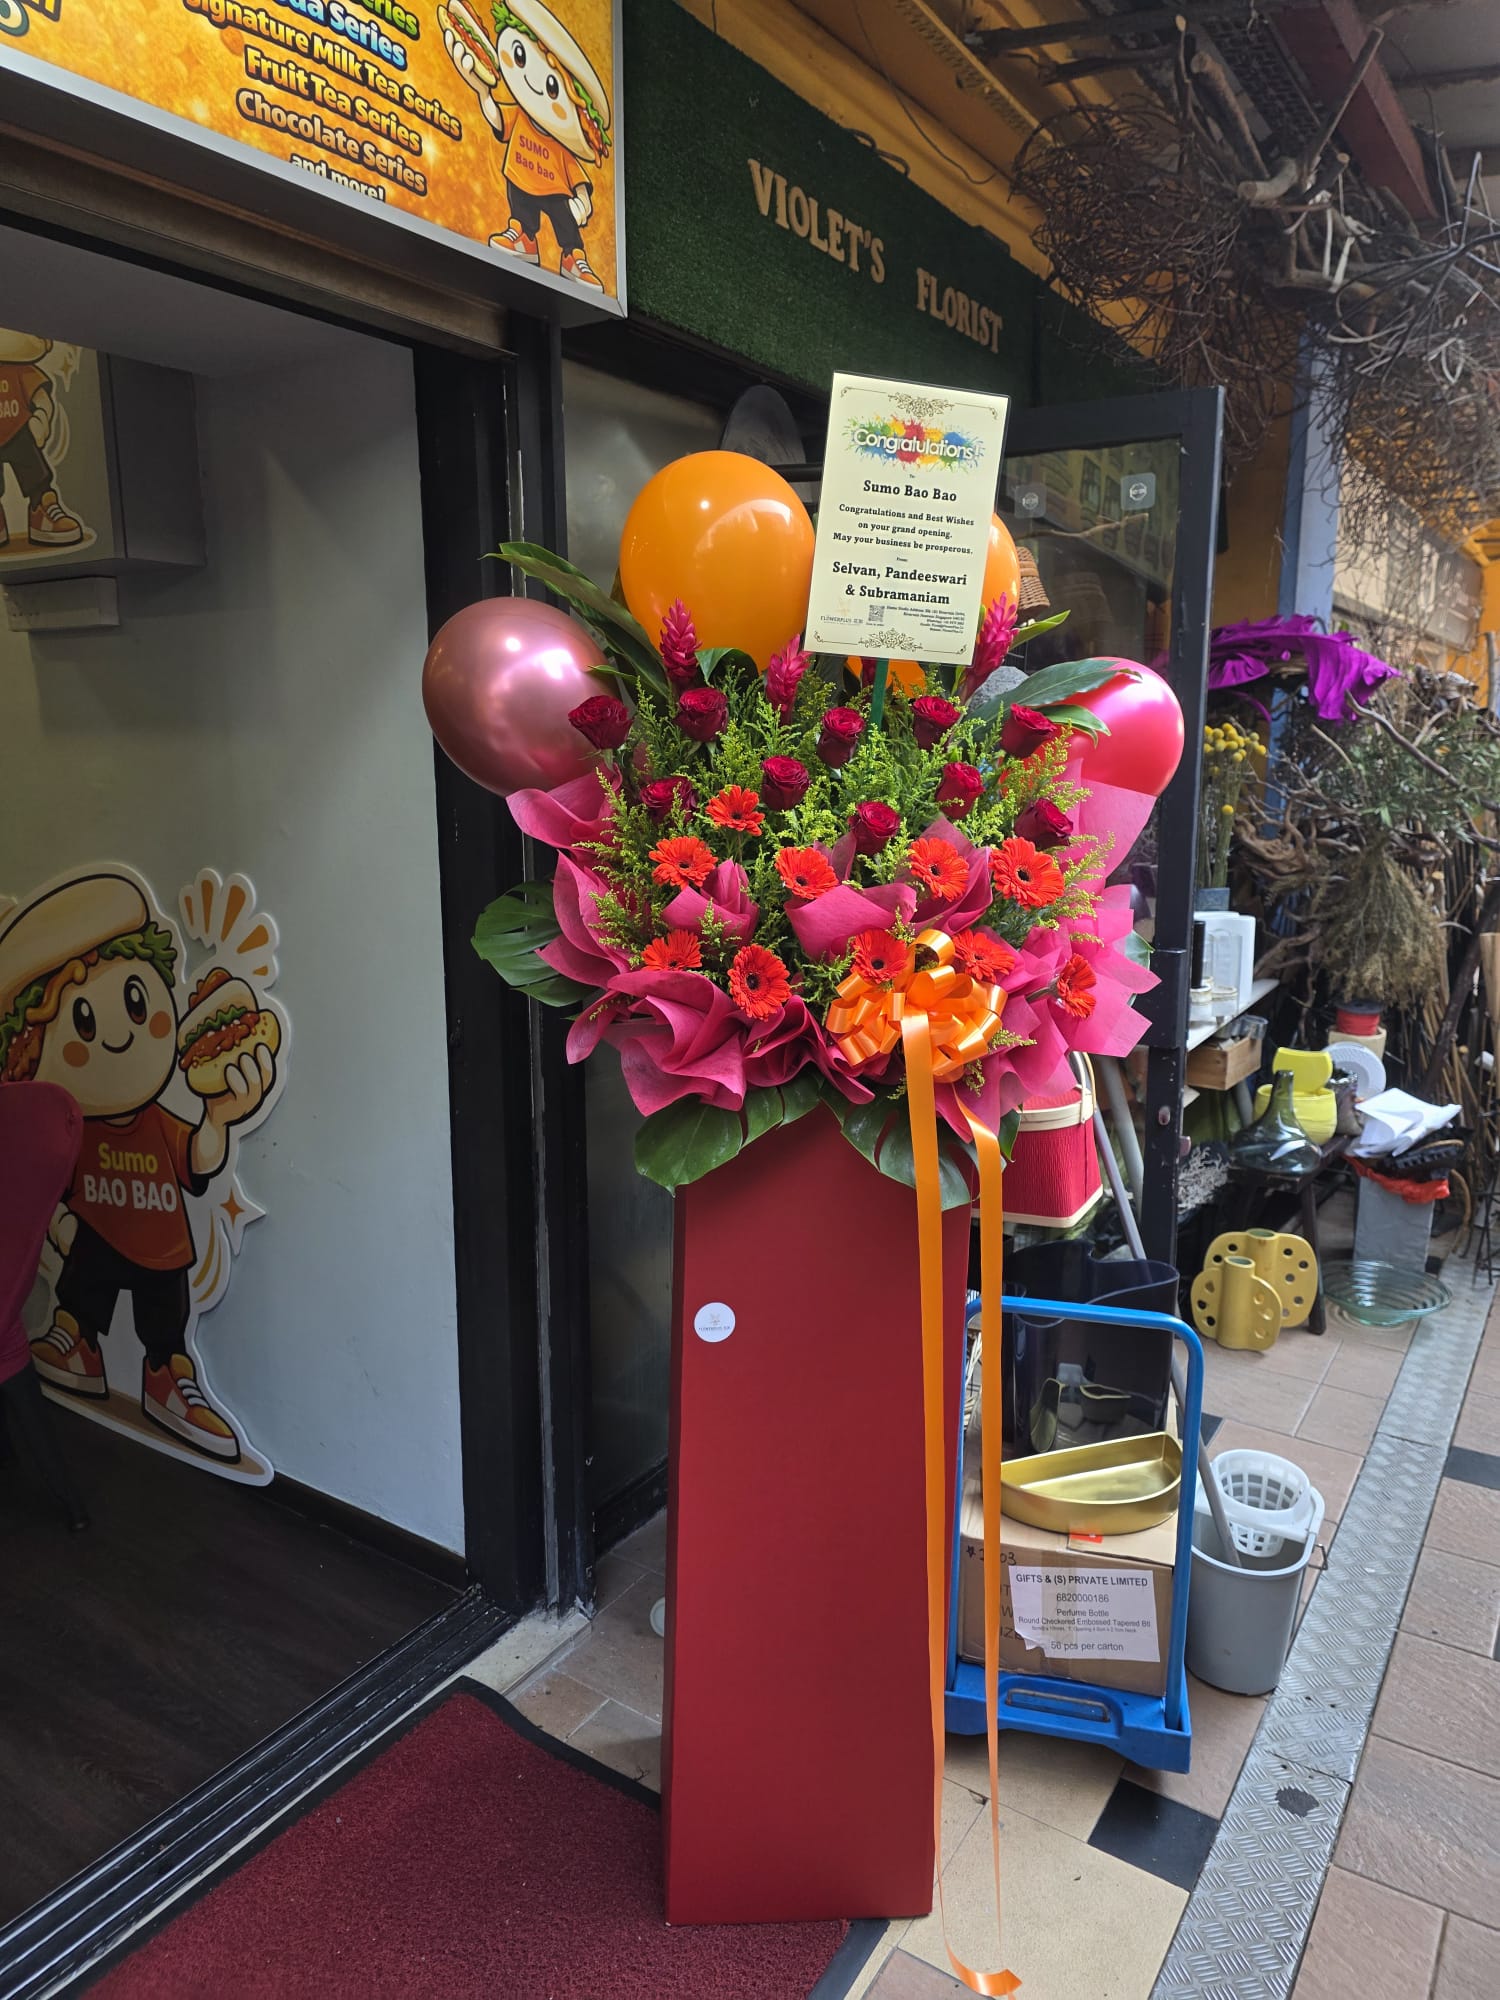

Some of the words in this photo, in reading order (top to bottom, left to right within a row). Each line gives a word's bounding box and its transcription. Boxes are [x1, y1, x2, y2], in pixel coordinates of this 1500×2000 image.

[328, 0, 406, 67] Series
[313, 34, 363, 81] Milk
[364, 61, 401, 102] Tea
[402, 85, 461, 138] Series
[246, 46, 309, 97] Fruit
[309, 73, 353, 117] Tea
[353, 97, 421, 152] Series
[237, 90, 360, 159] Chocolate
[362, 142, 426, 193] Series
[519, 134, 550, 160] SUMO
[515, 151, 535, 171] Bao
[536, 160, 555, 181] bao
[747, 158, 886, 284] VIOLET'S
[916, 267, 1003, 354] FLORIST
[863, 479, 900, 496] Sumo
[904, 484, 929, 499] Bao
[932, 487, 957, 502] Bao
[838, 503, 906, 519] Congratulations
[907, 513, 924, 521] and
[925, 513, 944, 523] Best
[945, 515, 975, 526] Wishes
[857, 521, 869, 529] on
[870, 522, 891, 532] your
[891, 525, 916, 535] grand
[917, 527, 953, 540] opening.
[832, 532, 852, 543] May
[854, 535, 874, 545] your
[875, 536, 912, 548] business
[913, 540, 924, 549] be
[925, 543, 974, 555] prosperous.
[832, 561, 881, 579] Selvan,
[884, 566, 967, 585] Pandeeswari
[845, 584, 856, 596] &
[859, 585, 950, 605] Subramaniam
[98, 1142, 159, 1175] Sumo
[83, 1174, 127, 1207] BAO
[131, 1180, 178, 1213] BAO
[1015, 1574, 1043, 1584] GIFTS
[1045, 1575, 1052, 1584] &
[1054, 1574, 1066, 1586] (S)
[1068, 1575, 1109, 1586] PRIVATE
[1110, 1576, 1148, 1587] LIMITED
[1018, 1616, 1040, 1625] Round
[1076, 1618, 1111, 1626] Embossed
[1056, 1608, 1087, 1617] Perfume
[1088, 1609, 1110, 1617] Bottle
[1064, 1643, 1079, 1653] pcs
[1081, 1643, 1095, 1652] per
[1097, 1642, 1124, 1651] carton
